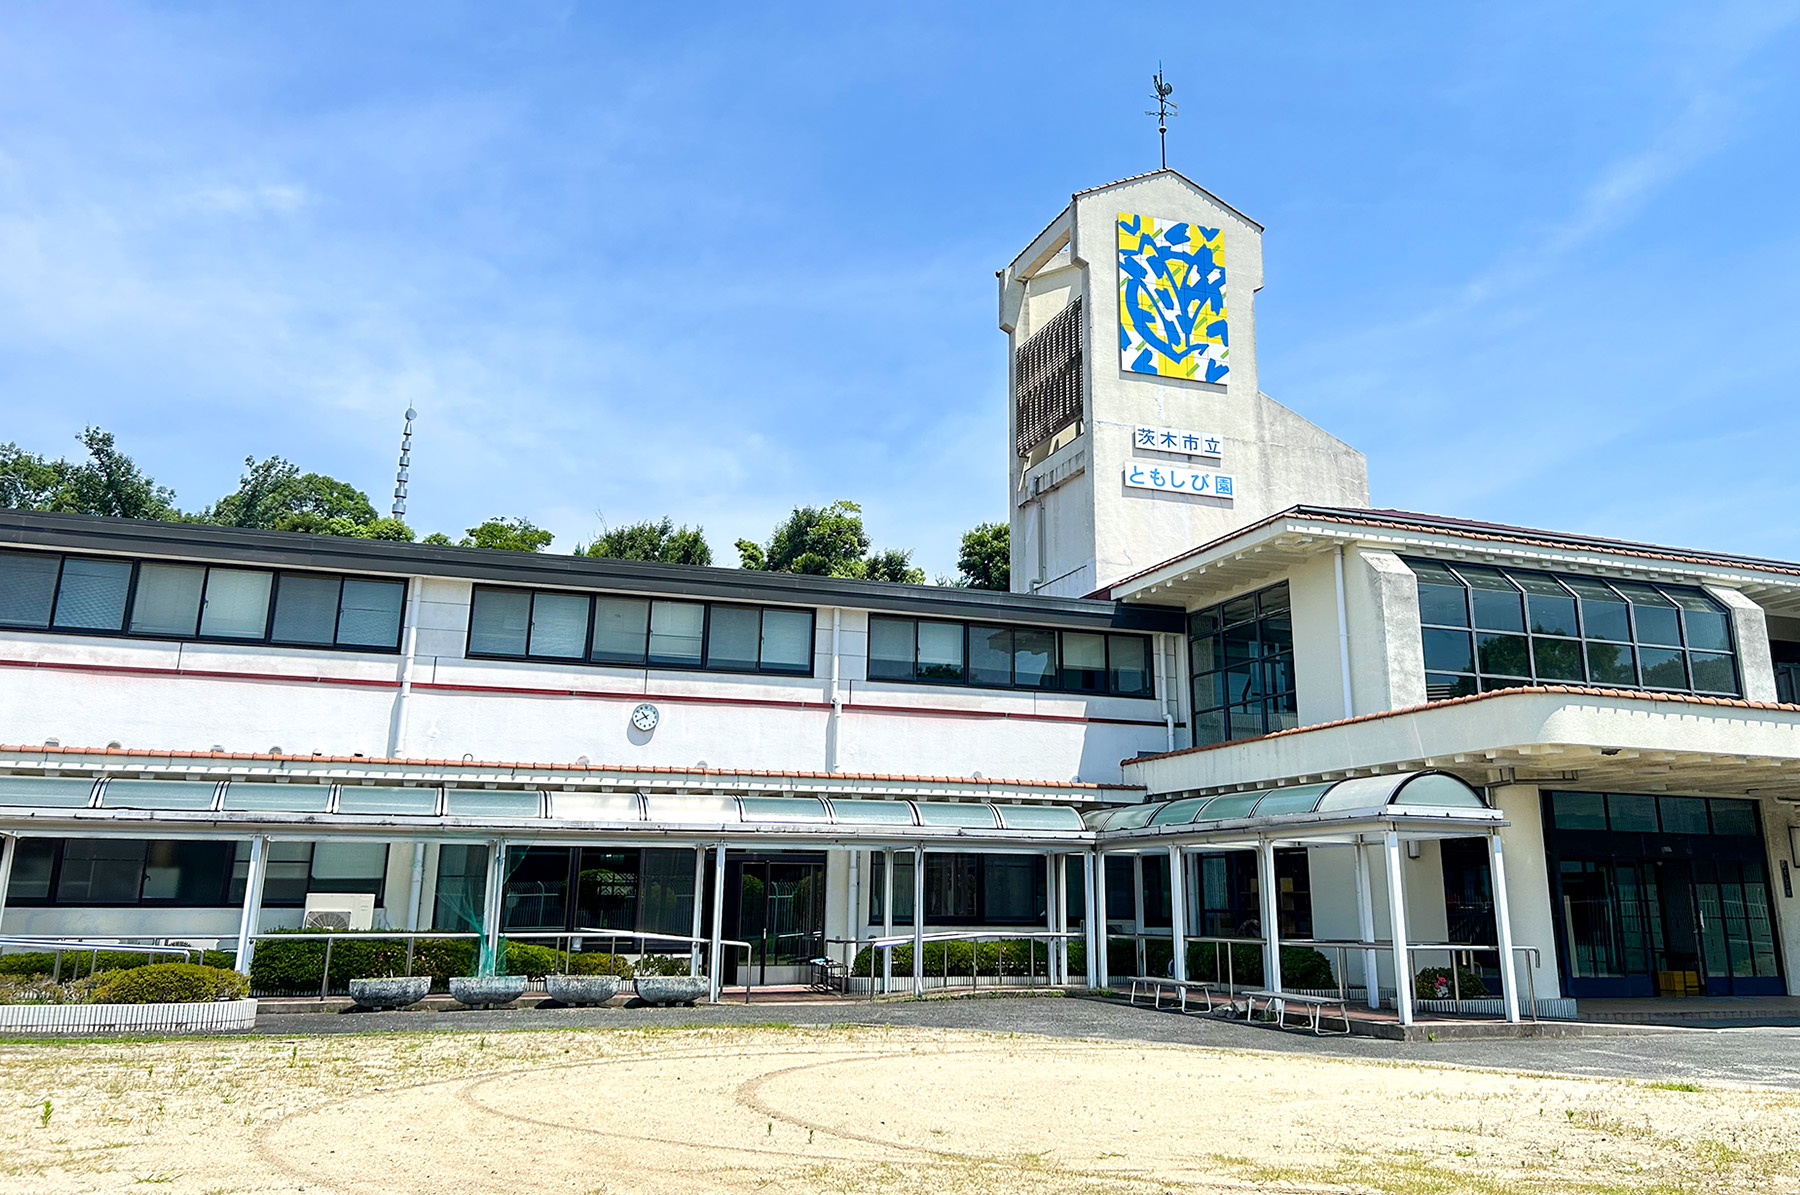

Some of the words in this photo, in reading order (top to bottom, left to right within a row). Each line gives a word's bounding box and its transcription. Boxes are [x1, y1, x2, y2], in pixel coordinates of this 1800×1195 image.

[1137, 427, 1222, 455] 茨木市立
[1129, 465, 1233, 496] ともしび園
